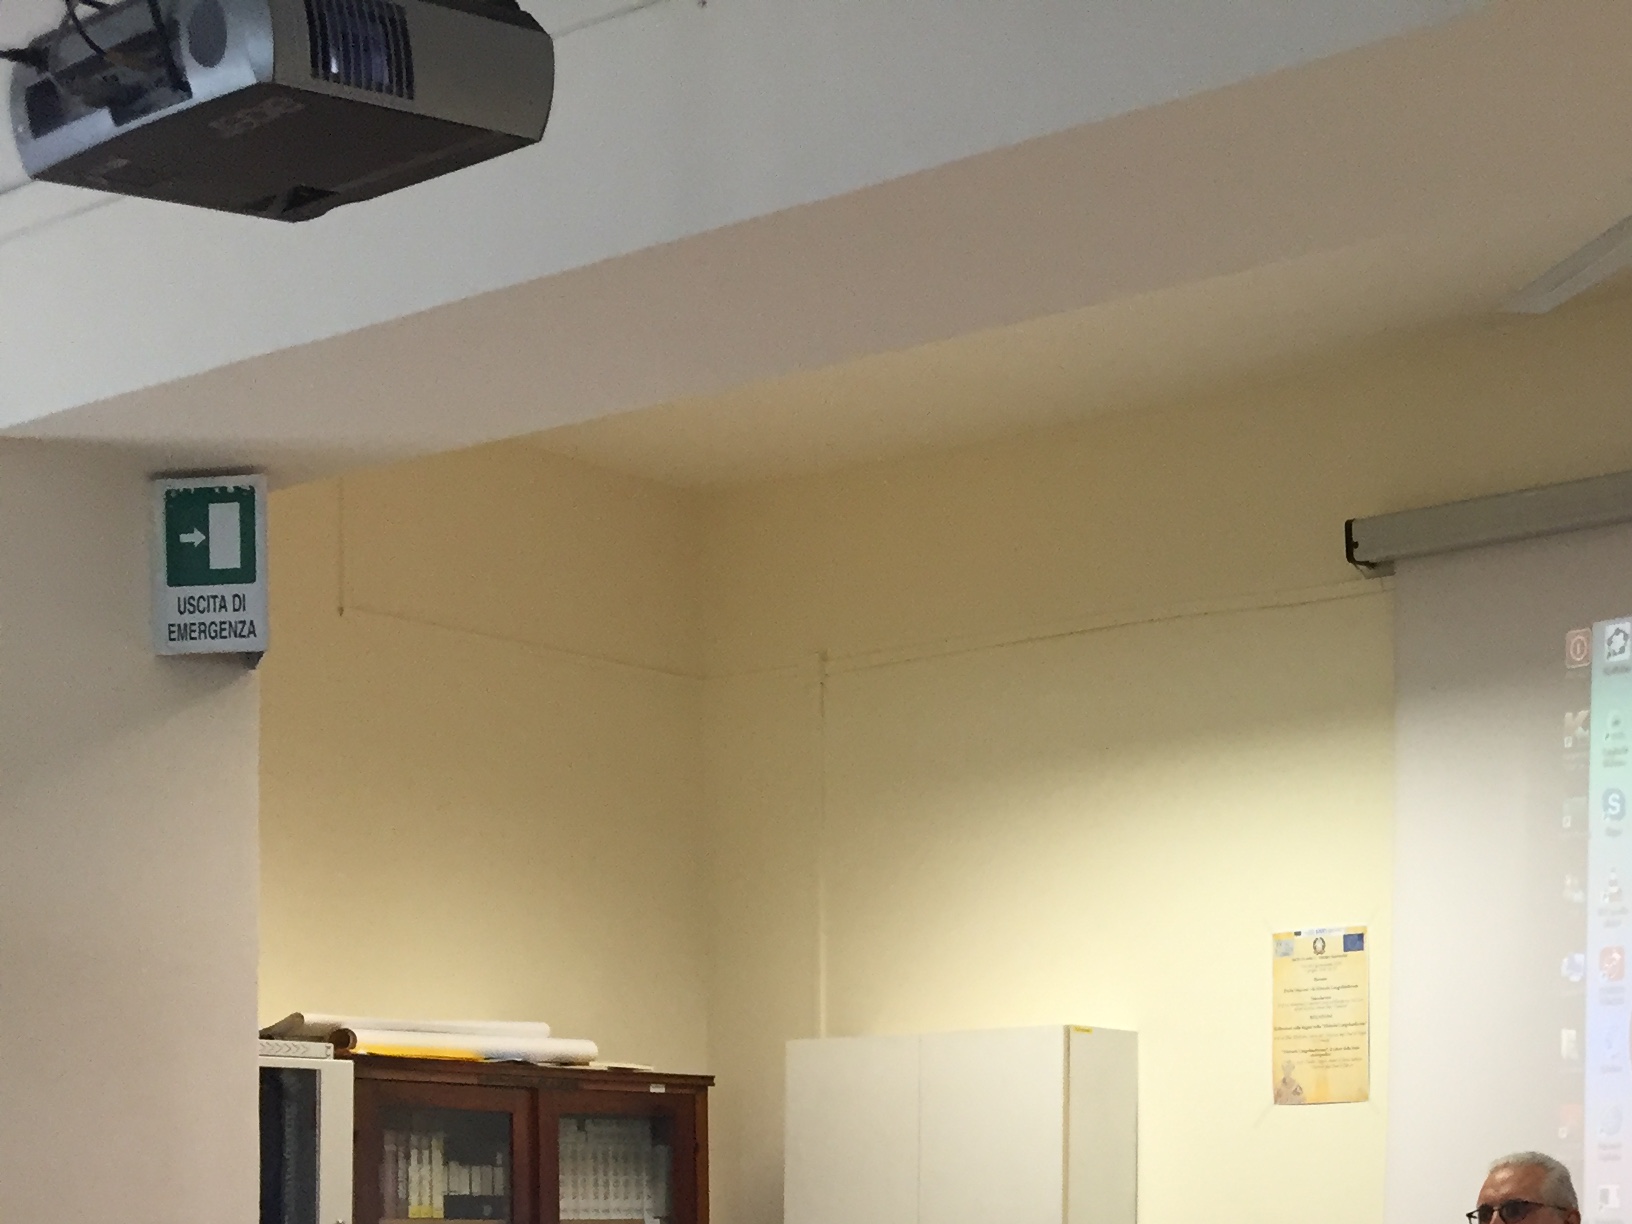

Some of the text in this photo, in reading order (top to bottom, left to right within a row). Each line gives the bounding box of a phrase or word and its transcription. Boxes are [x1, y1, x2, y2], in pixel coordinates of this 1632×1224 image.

[177, 594, 246, 615] USCITA DI
[168, 620, 257, 642] EMERGENZA
